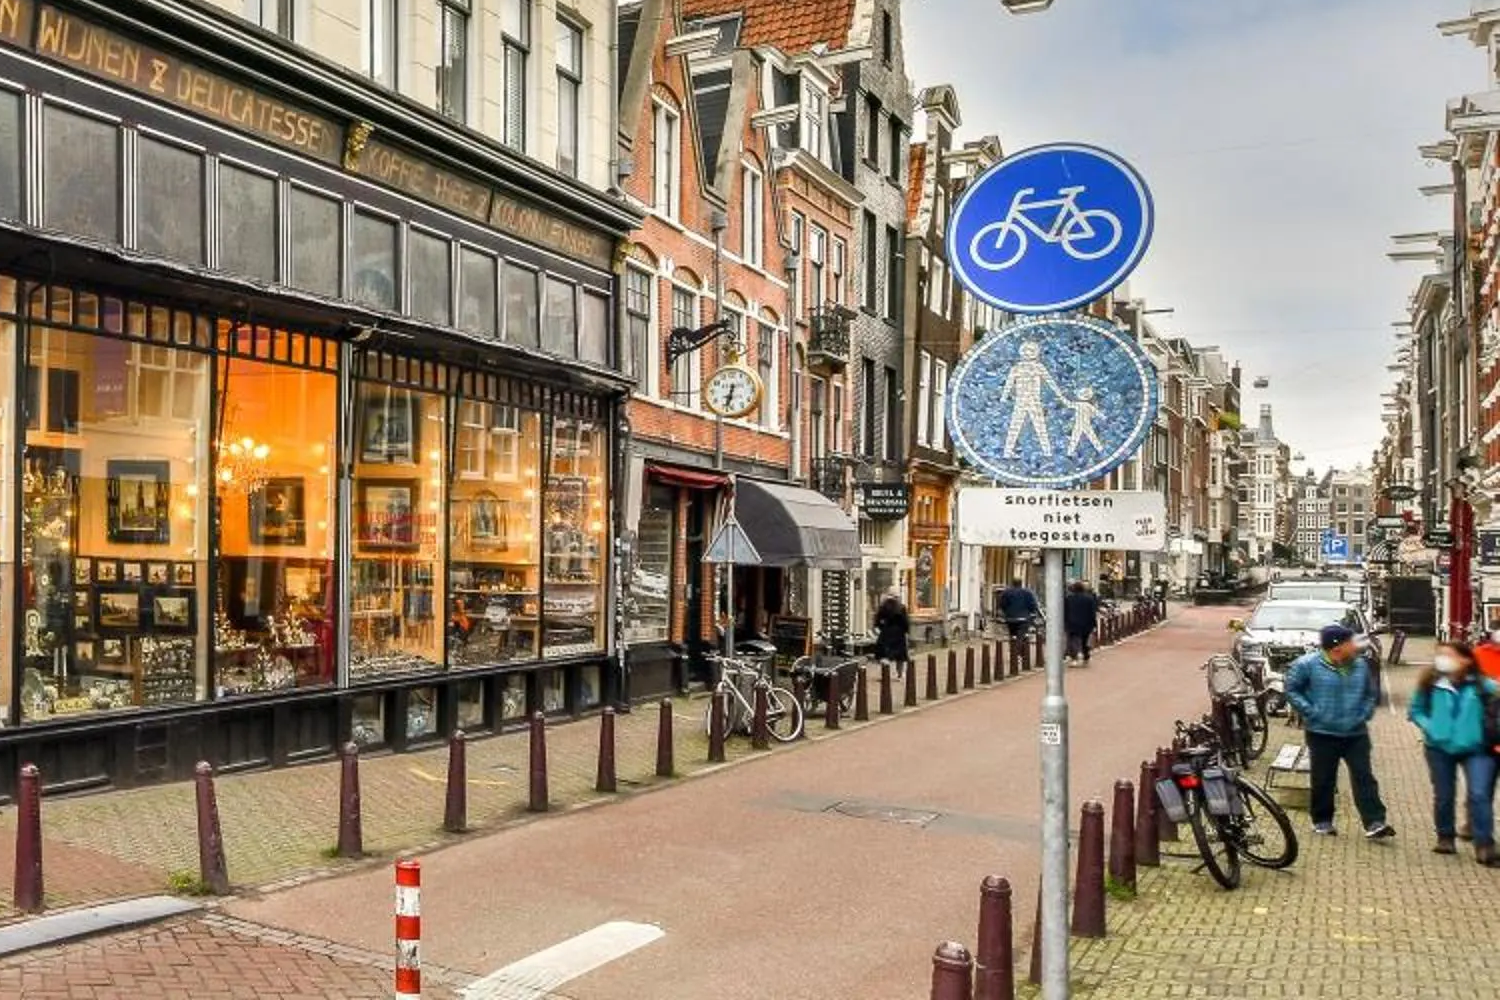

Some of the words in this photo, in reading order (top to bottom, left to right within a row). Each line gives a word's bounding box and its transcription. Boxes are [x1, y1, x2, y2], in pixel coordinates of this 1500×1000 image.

[39, 9, 140, 83] WIJNEN
[1005, 494, 1113, 508] snorfietsen
[1043, 512, 1081, 524] niet
[1010, 527, 1115, 544] toegestaan
